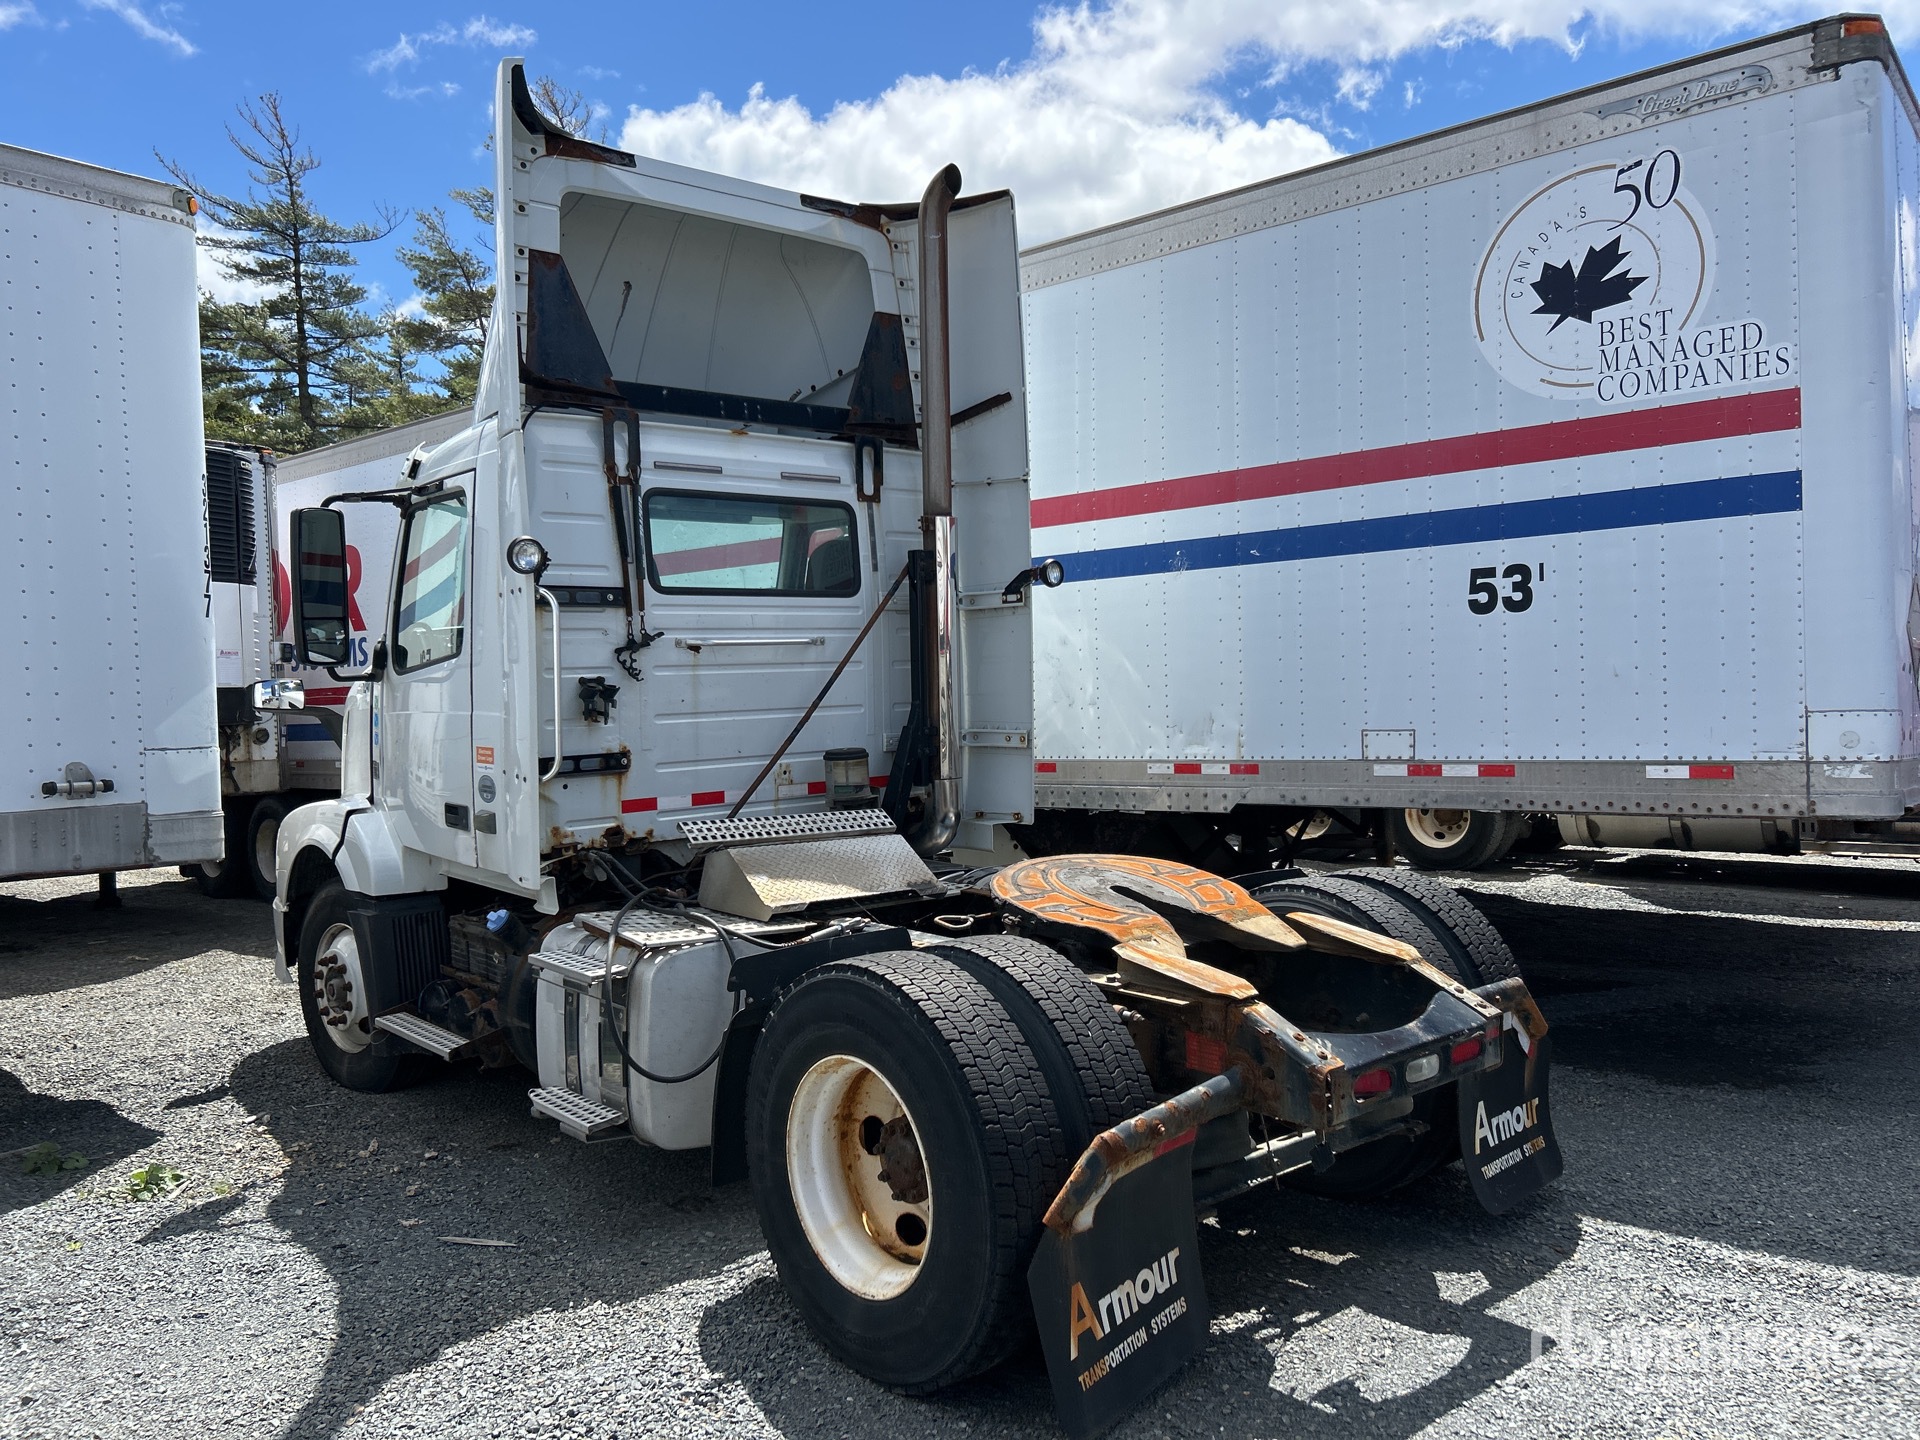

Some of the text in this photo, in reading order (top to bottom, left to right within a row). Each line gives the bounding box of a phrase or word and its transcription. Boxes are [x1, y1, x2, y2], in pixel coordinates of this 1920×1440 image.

[1641, 79, 1740, 115] Great Dane
[1607, 149, 1681, 232] 50
[1511, 206, 1587, 299] CANADA'S
[1597, 308, 1673, 348] BEST
[1597, 322, 1763, 375] MANAGED
[1597, 346, 1791, 402] COMPANIES
[1467, 562, 1545, 615] 53'
[1474, 1097, 1539, 1156] Armour
[1480, 1135, 1546, 1180] TRANSPORTATION SYSTEMS
[1070, 1247, 1180, 1362] Armour
[1078, 1296, 1187, 1392] TRANSPORTATION SYSTEMS
